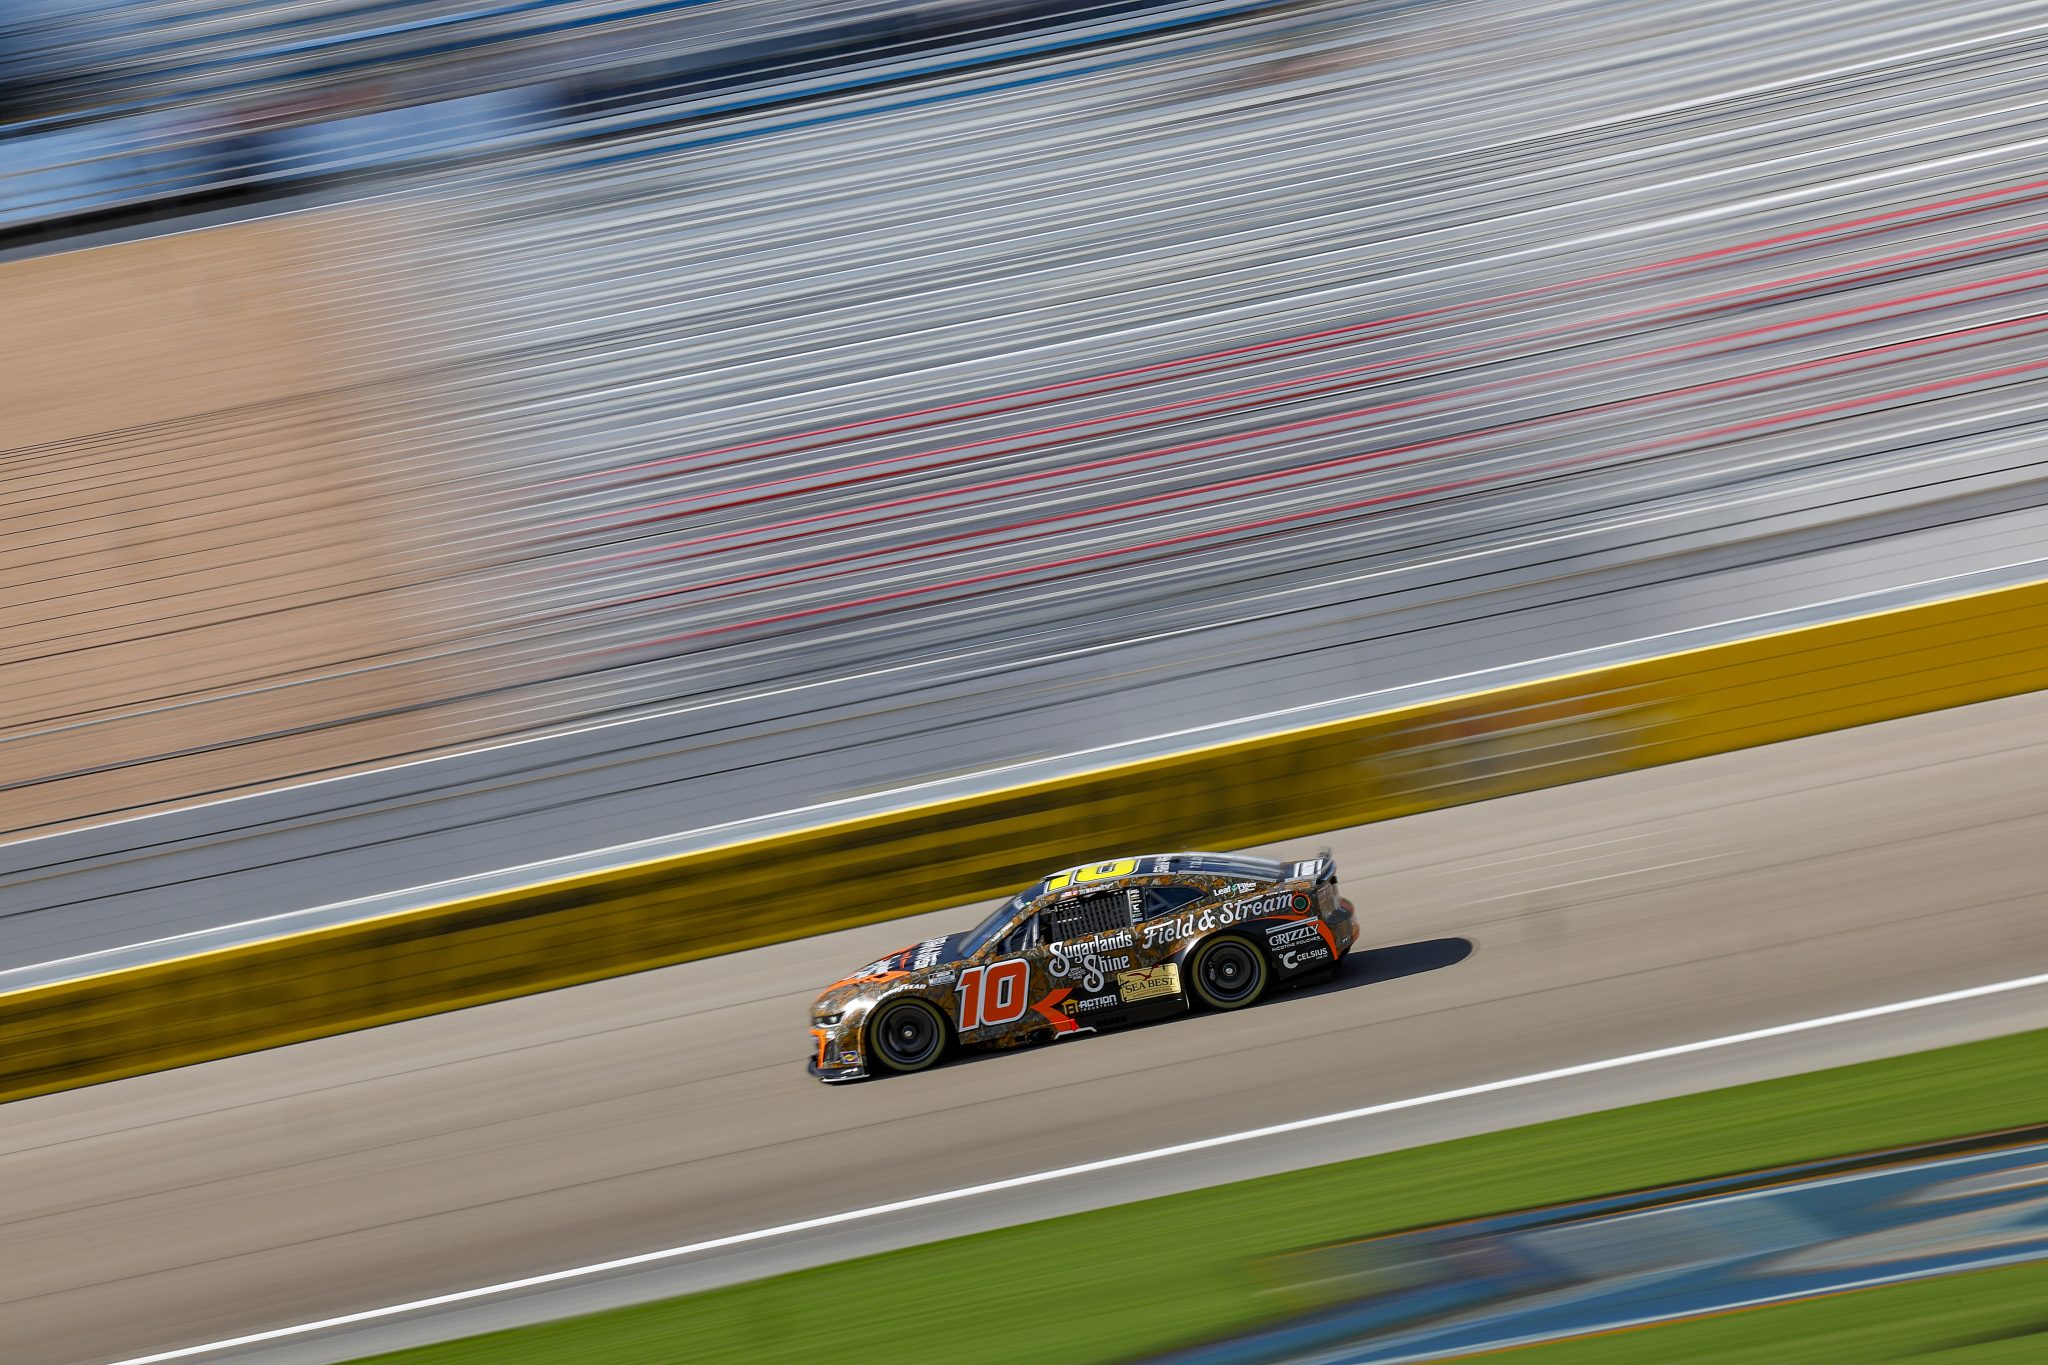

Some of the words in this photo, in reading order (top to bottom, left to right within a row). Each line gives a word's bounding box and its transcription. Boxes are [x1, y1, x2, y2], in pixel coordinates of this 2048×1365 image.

[1213, 886, 1232, 897] Leaf
[1237, 882, 1257, 892] Filter
[1142, 914, 1194, 949] Field
[1198, 908, 1215, 931] &
[1219, 893, 1293, 924] Stream
[1268, 924, 1319, 946] GRIZZLY
[1049, 931, 1134, 978] Sugarlands
[1296, 948, 1328, 962] CELSIUS
[1083, 954, 1130, 993] Shine
[955, 958, 1030, 1032] 10
[1125, 981, 1146, 994] SEA
[1147, 977, 1175, 988] BEST
[1078, 994, 1117, 1009] ACTION
